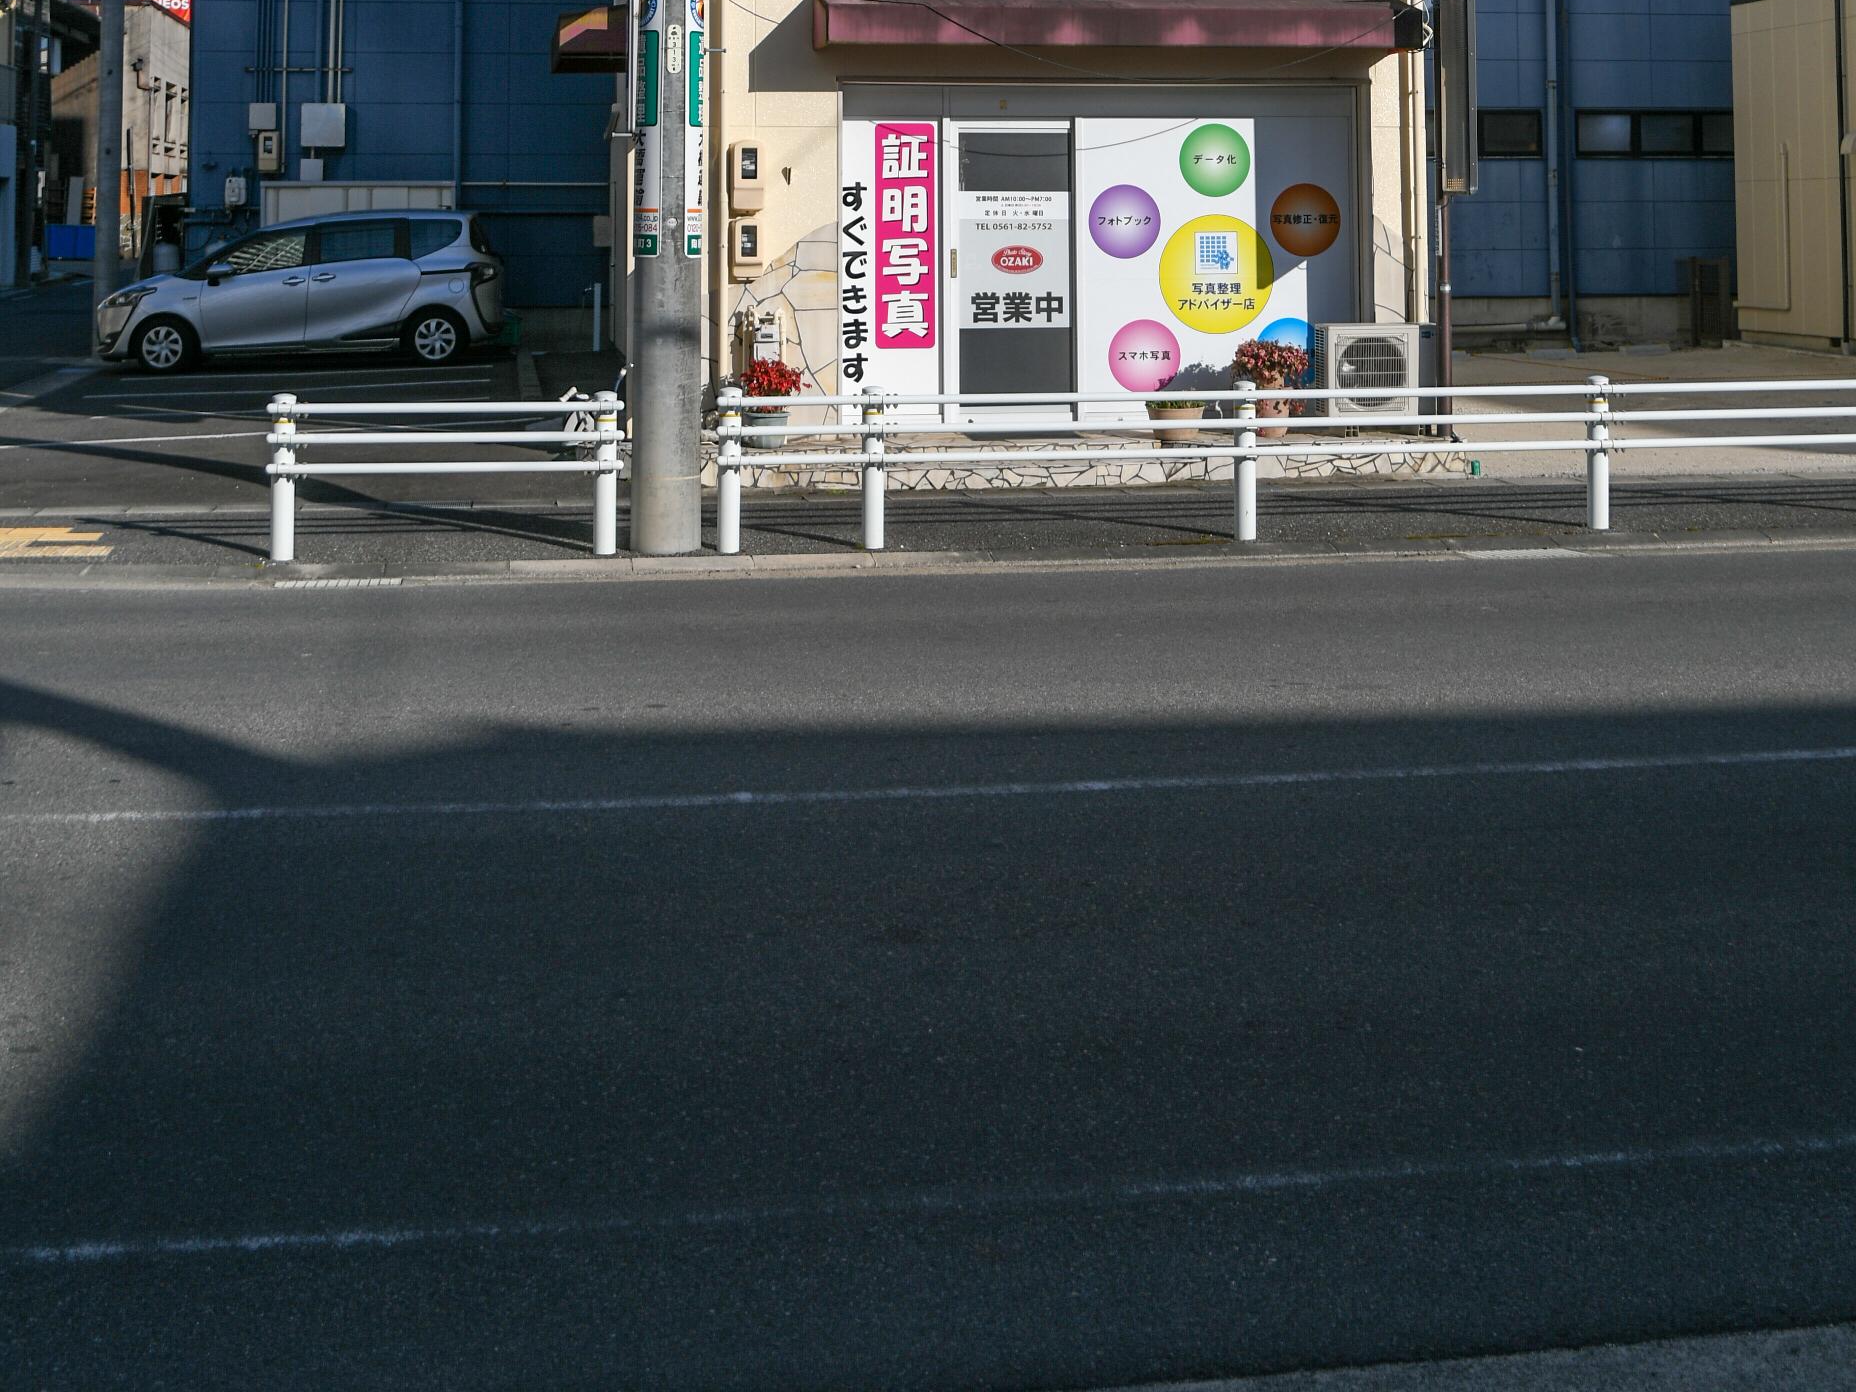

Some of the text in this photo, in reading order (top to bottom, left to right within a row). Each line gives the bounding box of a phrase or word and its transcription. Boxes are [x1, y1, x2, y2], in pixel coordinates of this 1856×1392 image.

[1193, 154, 1237, 165] データ化
[1098, 216, 1152, 226] フォトブック
[881, 133, 929, 338] 証明写真
[1000, 257, 1033, 266] OZAKI
[842, 182, 868, 383] すぐできます
[1192, 282, 1242, 295] 写真整理
[971, 291, 1064, 323] 営業中
[1177, 298, 1255, 310] アドバイザー店
[1118, 351, 1171, 361] スマホ写真
